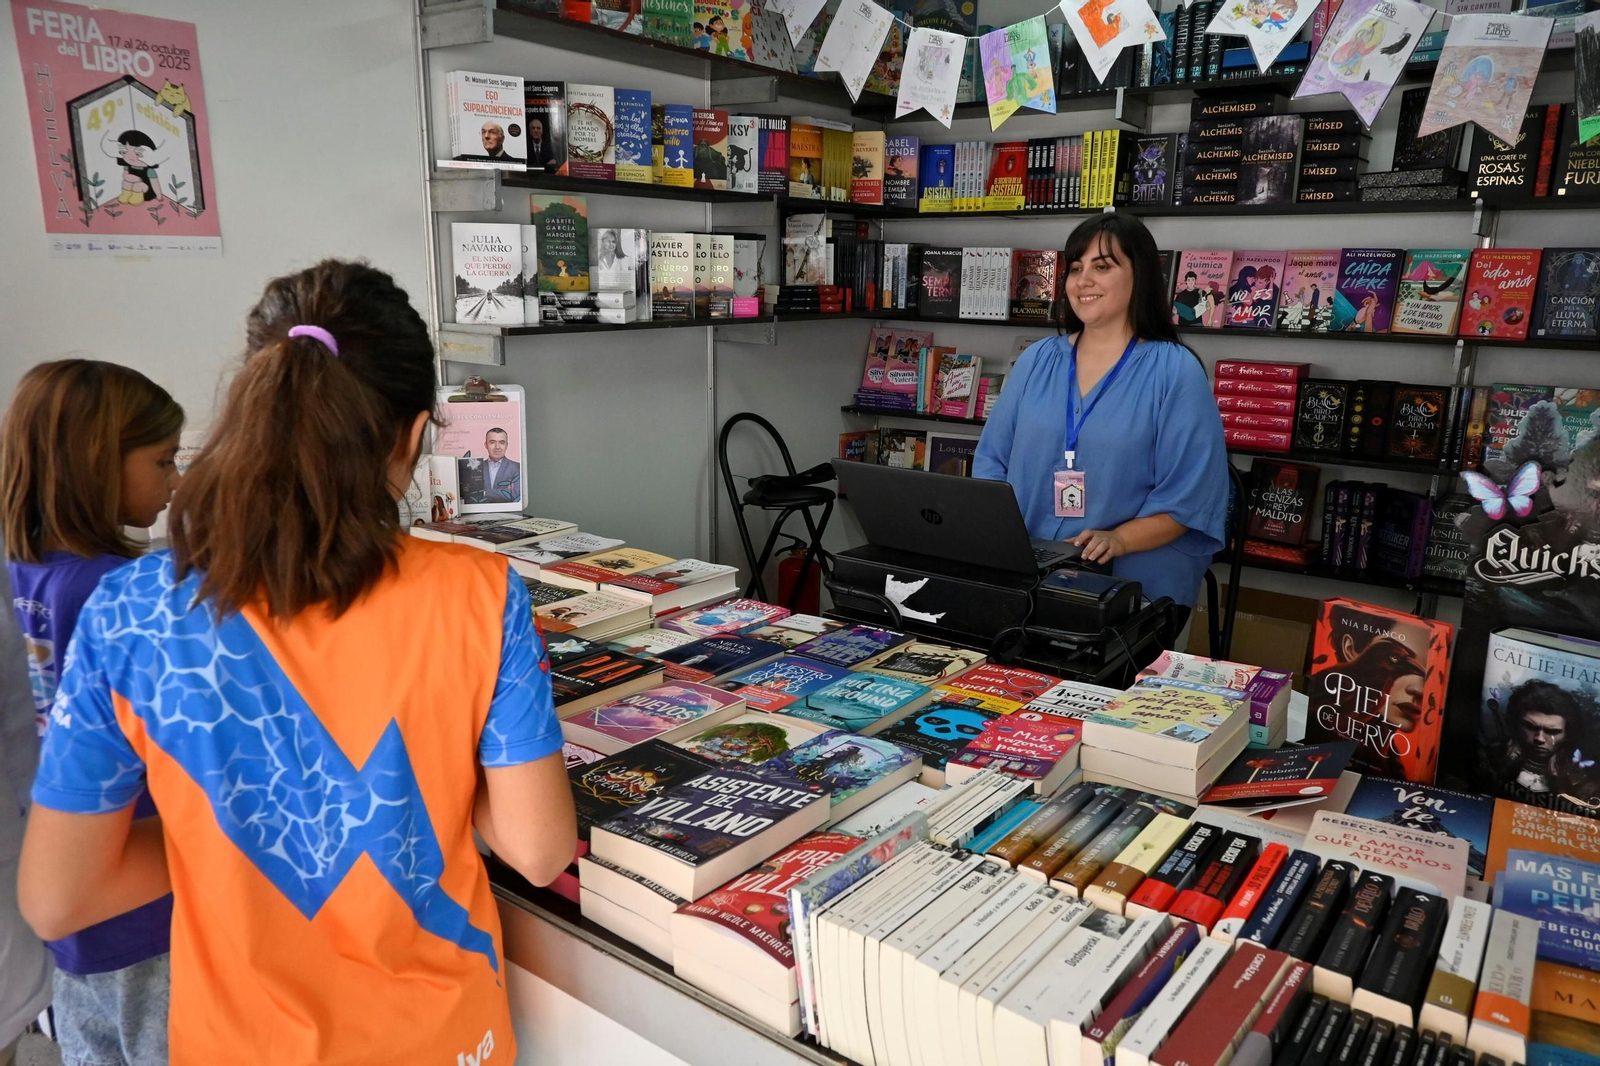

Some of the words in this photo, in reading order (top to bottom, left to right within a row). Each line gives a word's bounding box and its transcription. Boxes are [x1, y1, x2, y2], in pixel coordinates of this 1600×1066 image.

[1456, 4, 1468, 12] SIN
[1470, 2, 1501, 12] CONTROL
[26, 8, 105, 44] FERIA
[1484, 25, 1510, 38] Libro
[109, 35, 120, 48] 17
[124, 37, 133, 50] al
[135, 39, 149, 52] 26
[152, 41, 190, 58] octubre
[58, 41, 79, 56] del
[81, 42, 154, 77] LIBRO
[158, 54, 191, 71] 2025
[500, 79, 517, 87] Segarra
[486, 91, 498, 100] EGO
[463, 103, 522, 117] SUPRACONCIENCIA
[1202, 103, 1256, 114] ALCHEMISED
[136, 102, 180, 137] edición
[769, 118, 786, 130] VALLÉS
[35, 63, 73, 219] HUELVA
[1242, 152, 1293, 162] ALCHEMISED
[1479, 163, 1519, 174] ROSAS
[1476, 175, 1524, 186] ESPINAS
[990, 186, 1023, 196] ASISTENTA
[471, 235, 502, 243] JULIA
[652, 241, 682, 249] JAVIER
[462, 244, 512, 252] NAVARRO
[483, 262, 511, 270] PERDIÓ
[1186, 261, 1223, 270] química
[1288, 259, 1314, 268] Jaque
[1345, 259, 1391, 276] CAÍDA
[1483, 263, 1511, 279] odio
[1342, 276, 1389, 290] LIBRE
[1498, 275, 1535, 290] amor
[1231, 291, 1248, 301] NO
[1253, 289, 1272, 300] ES
[1551, 296, 1595, 305] CANCIÓN
[1013, 307, 1049, 316] BLACKWATER
[1232, 305, 1271, 318] AMOR
[1421, 303, 1440, 312] AMOR
[1417, 310, 1443, 321] VERANO
[1403, 317, 1443, 330] COMPLICADO
[1551, 320, 1587, 328] ETERNA
[1302, 413, 1340, 423] ACADEMY
[1395, 421, 1437, 430] ACADEMY
[939, 444, 956, 452] Los
[1276, 488, 1292, 496] LAS
[1262, 492, 1303, 507] CENIZAS
[1272, 502, 1289, 511] REY
[923, 510, 940, 524] hp
[1255, 507, 1302, 523] MALDITO
[1341, 618, 1359, 629] NÍA
[1363, 624, 1406, 642] BLANCO
[1493, 648, 1555, 674] CALLIE
[969, 673, 1005, 684] para
[951, 681, 1005, 695] expertos
[1147, 676, 1194, 690] VIOLETA
[1197, 685, 1241, 697] REED
[826, 688, 898, 708] AROUND
[1054, 699, 1098, 711] para
[1129, 693, 1219, 712] perfecto
[1324, 672, 1402, 729] PIEL
[623, 695, 697, 720] NUEVOS
[791, 709, 821, 719] EMILY
[820, 715, 845, 725] RATH
[1131, 710, 1185, 722] amor
[1322, 711, 1334, 723] DE
[1013, 731, 1049, 743] Mil
[1316, 704, 1411, 758] CUERVO
[997, 737, 1053, 751] razones
[607, 766, 666, 796] ÚLTIMA
[682, 774, 821, 809] ASISTENTE
[1418, 784, 1484, 802] MONCOMBLE
[703, 794, 737, 809] DEL
[1392, 786, 1457, 814] Ven,
[633, 796, 774, 837] VILLANO
[1401, 806, 1434, 823] te
[1321, 817, 1388, 836] REBECCA
[1394, 833, 1455, 850] YARROS
[603, 823, 632, 835] HANNAH
[634, 833, 657, 847] NICOLE
[659, 843, 699, 862] MAEHRER
[1342, 832, 1360, 840] EL
[1364, 838, 1426, 856] AMOR
[1314, 834, 1349, 847] QUE
[1358, 842, 1452, 871] DEJAMOS
[1349, 850, 1409, 869] ATRÁS
[1515, 859, 1573, 879] MÁS
[960, 875, 983, 891] Hesse
[1552, 879, 1600, 900] QUE
[1026, 898, 1043, 912] Kafka
[1061, 906, 1082, 923] Golding
[687, 904, 717, 918] HANNAH
[719, 910, 748, 929] NICOLE
[749, 926, 793, 958] MAEHRER
[1158, 927, 1186, 958] HEMINGWAY
[1064, 936, 1101, 967] Dostoyevski
